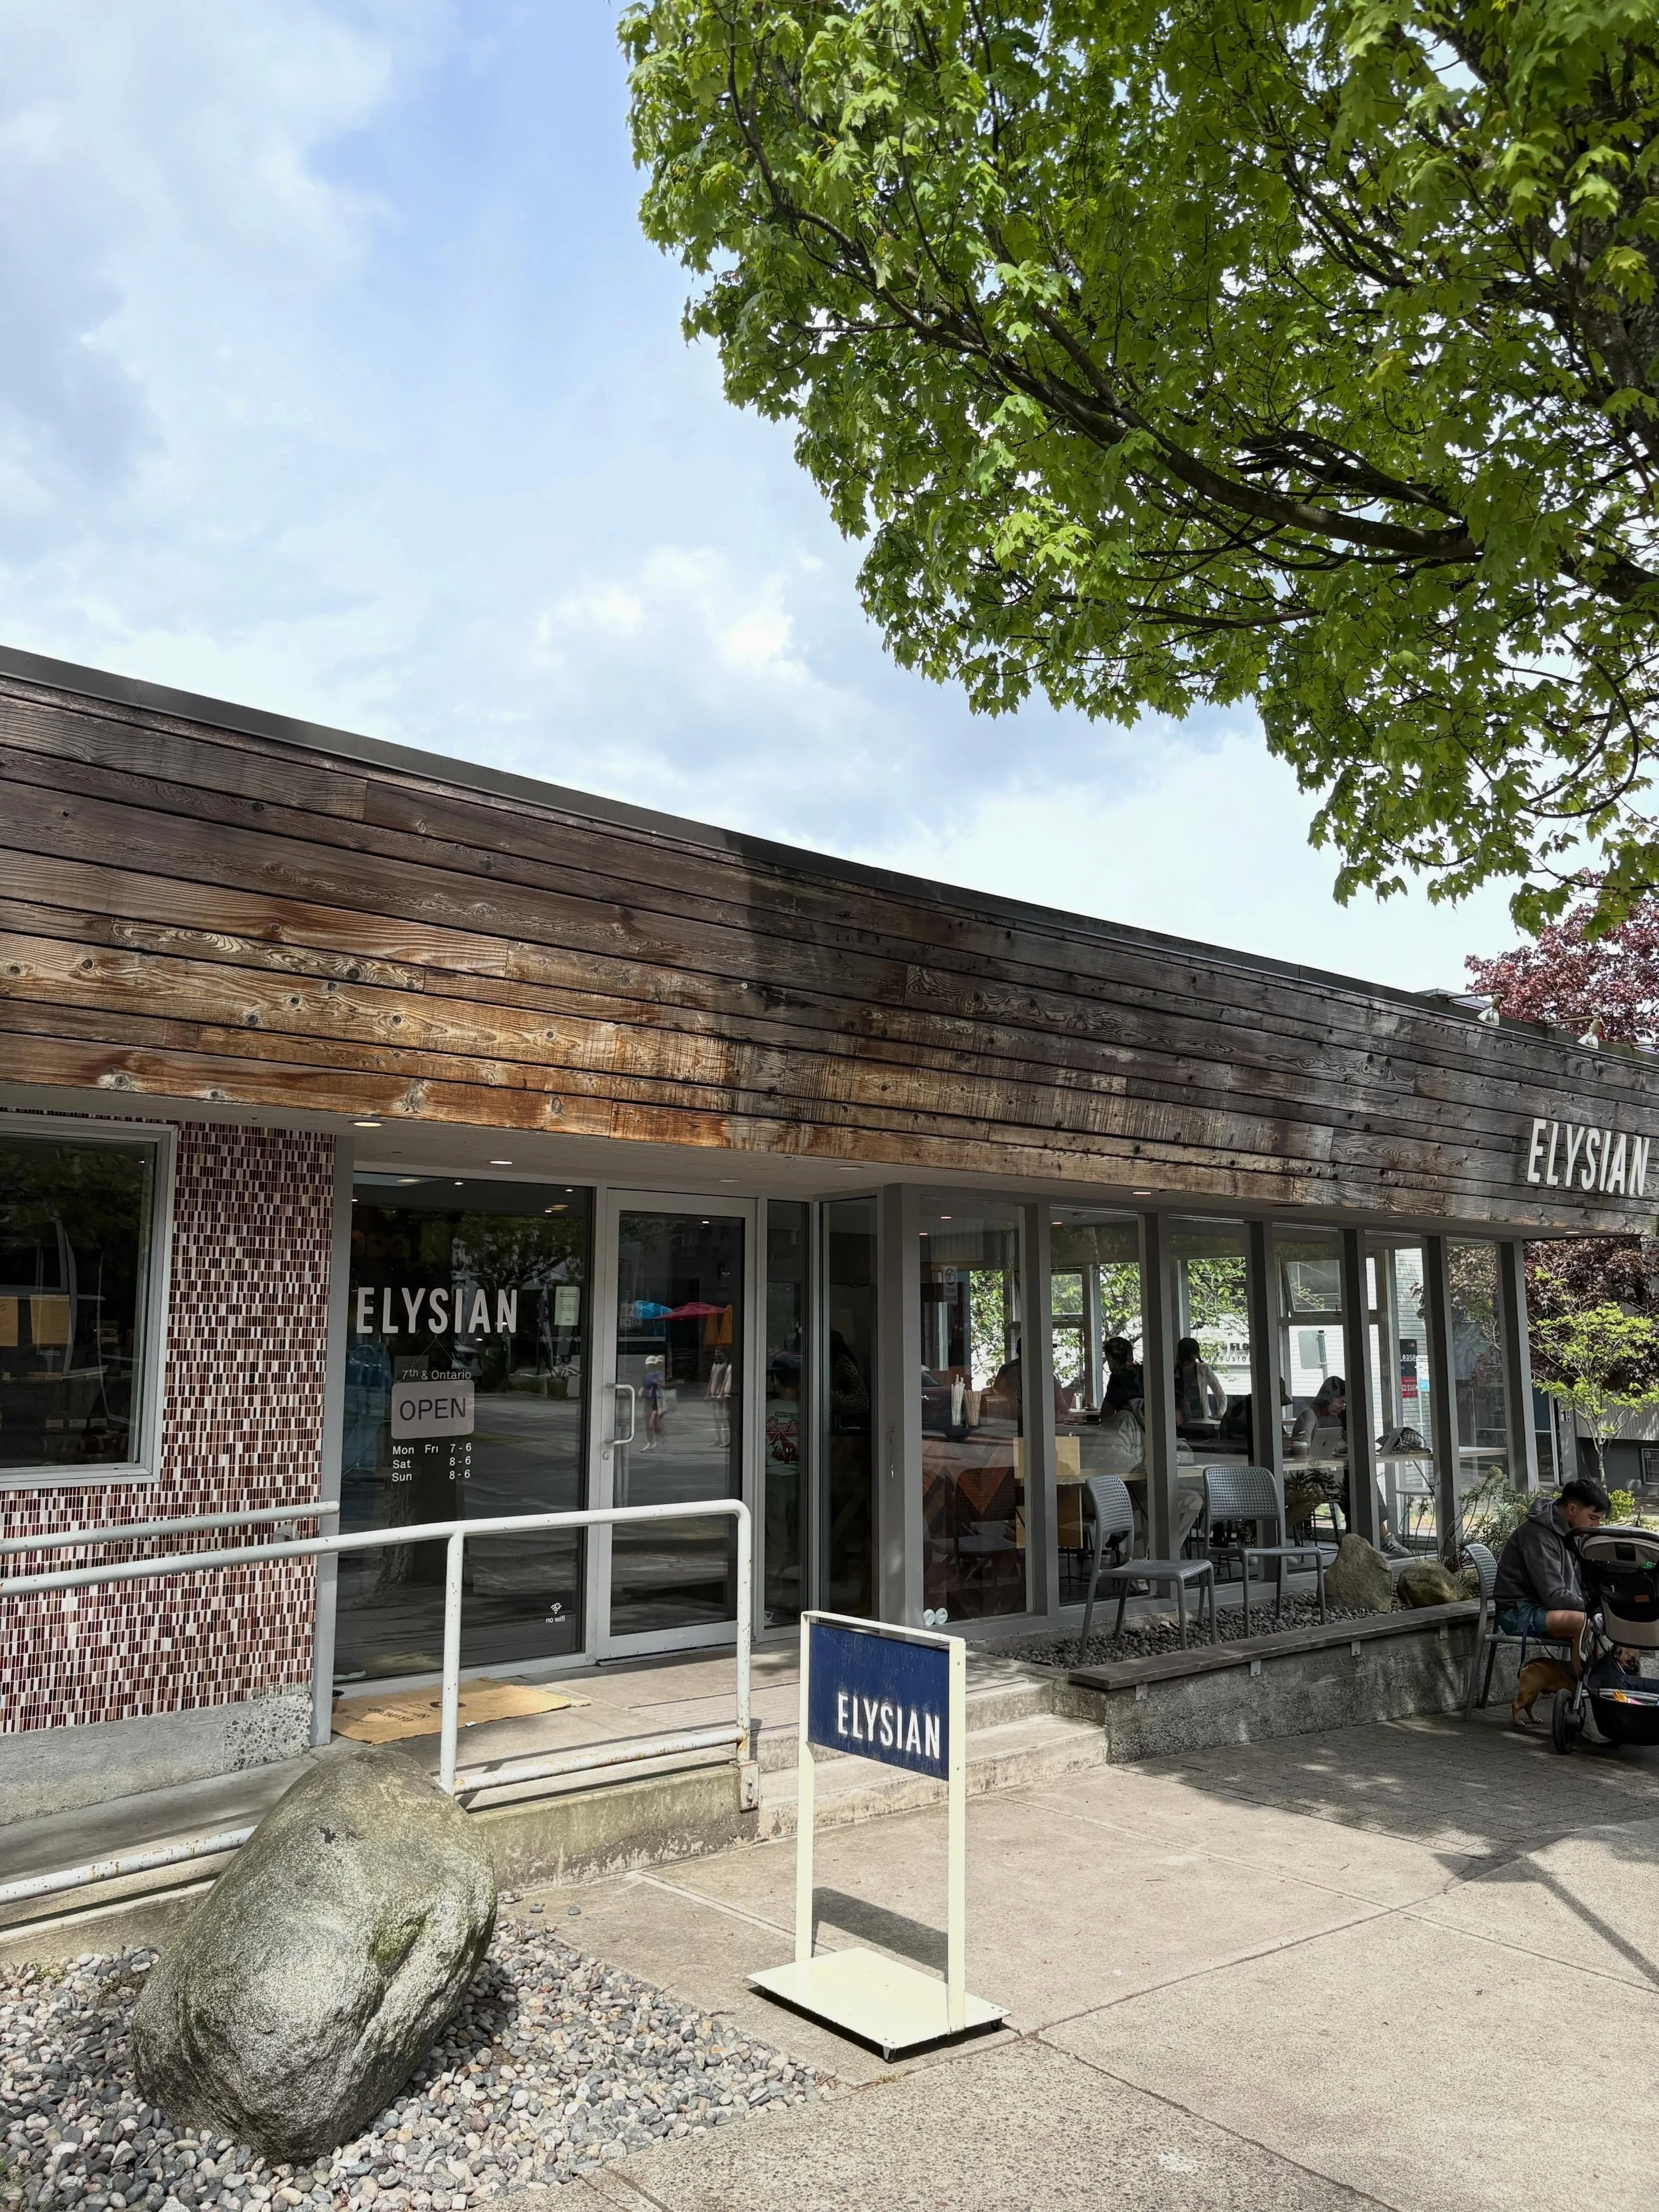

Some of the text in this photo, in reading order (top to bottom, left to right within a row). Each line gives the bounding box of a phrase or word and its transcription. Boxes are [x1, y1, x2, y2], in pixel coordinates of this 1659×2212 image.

[1528, 1118, 1650, 1195] ELYSIAN
[356, 1288, 518, 1334] ELYSIAN
[402, 1368, 472, 1380] 7th & Ontario
[399, 1398, 466, 1422] OPEN
[393, 1445, 414, 1455] Mon
[425, 1444, 438, 1453] Fri
[393, 1459, 411, 1469] Sat
[392, 1473, 412, 1482] Sun
[837, 1692, 940, 1759] ELYSIAN
